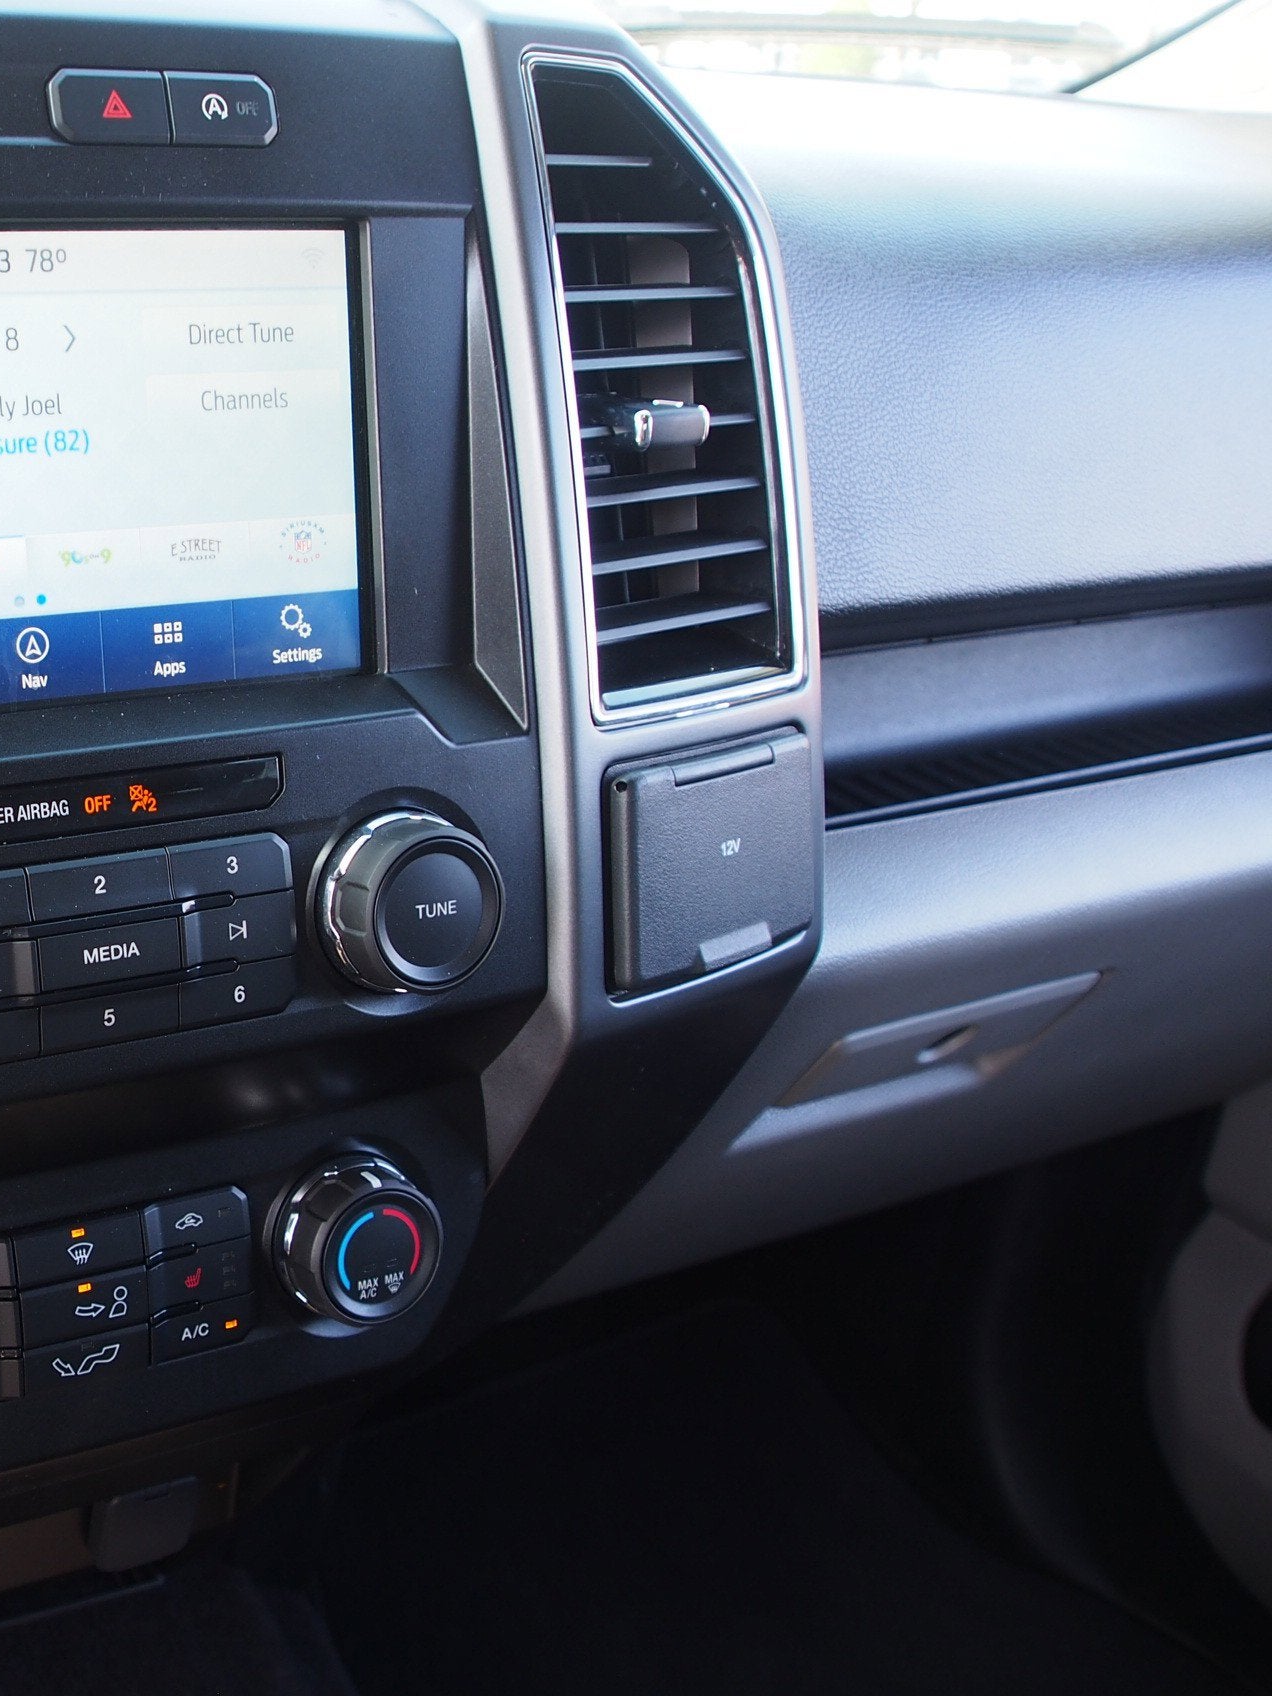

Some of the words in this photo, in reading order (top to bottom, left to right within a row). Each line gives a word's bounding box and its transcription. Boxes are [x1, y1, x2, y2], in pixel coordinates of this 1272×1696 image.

[235, 100, 260, 117] OFF
[5, 327, 20, 352] 8
[188, 323, 244, 345] Direct
[248, 322, 295, 344] Tune
[21, 393, 63, 418] Joel
[200, 387, 289, 412] Channels
[44, 430, 90, 458] (82)
[171, 543, 178, 557] E
[180, 538, 222, 554] STREET
[272, 646, 323, 665] Settings
[153, 660, 186, 678] Apps
[21, 673, 49, 690] Nav
[16, 799, 70, 822] AIRBAG
[84, 794, 112, 815] OFF
[720, 838, 742, 857] 12V
[226, 855, 239, 875] 3
[93, 875, 107, 895] 2
[415, 900, 458, 920] TUNE
[83, 941, 141, 965] MEDIA
[233, 984, 246, 1004] 6
[103, 1008, 116, 1027] 5
[357, 1277, 379, 1292] MAX
[384, 1270, 405, 1285] MAX
[359, 1287, 378, 1300] A/C
[181, 1322, 210, 1342] A/C
